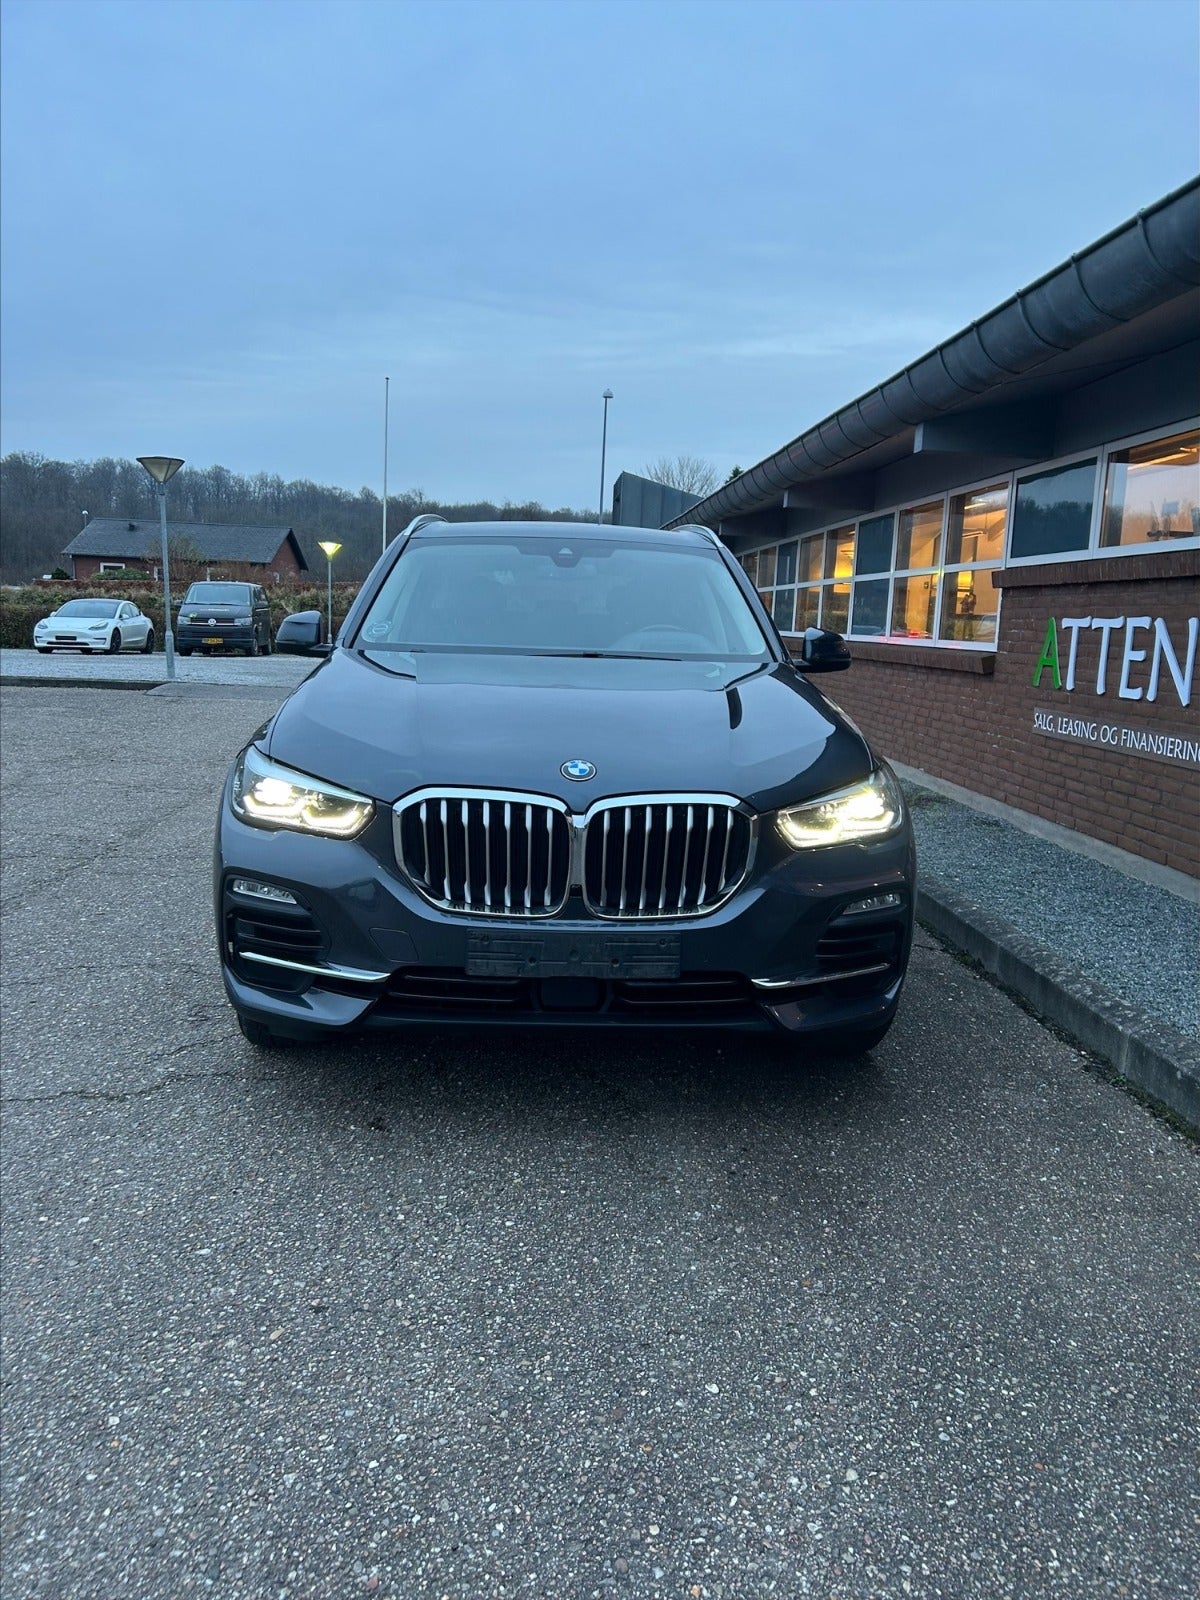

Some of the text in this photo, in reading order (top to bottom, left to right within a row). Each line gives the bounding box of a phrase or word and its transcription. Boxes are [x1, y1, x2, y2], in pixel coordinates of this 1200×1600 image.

[1033, 616, 1199, 707] ATTEN
[1058, 716, 1097, 741] LEASING
[1100, 725, 1118, 745] OG
[1121, 729, 1200, 763] FINANSIERIN
